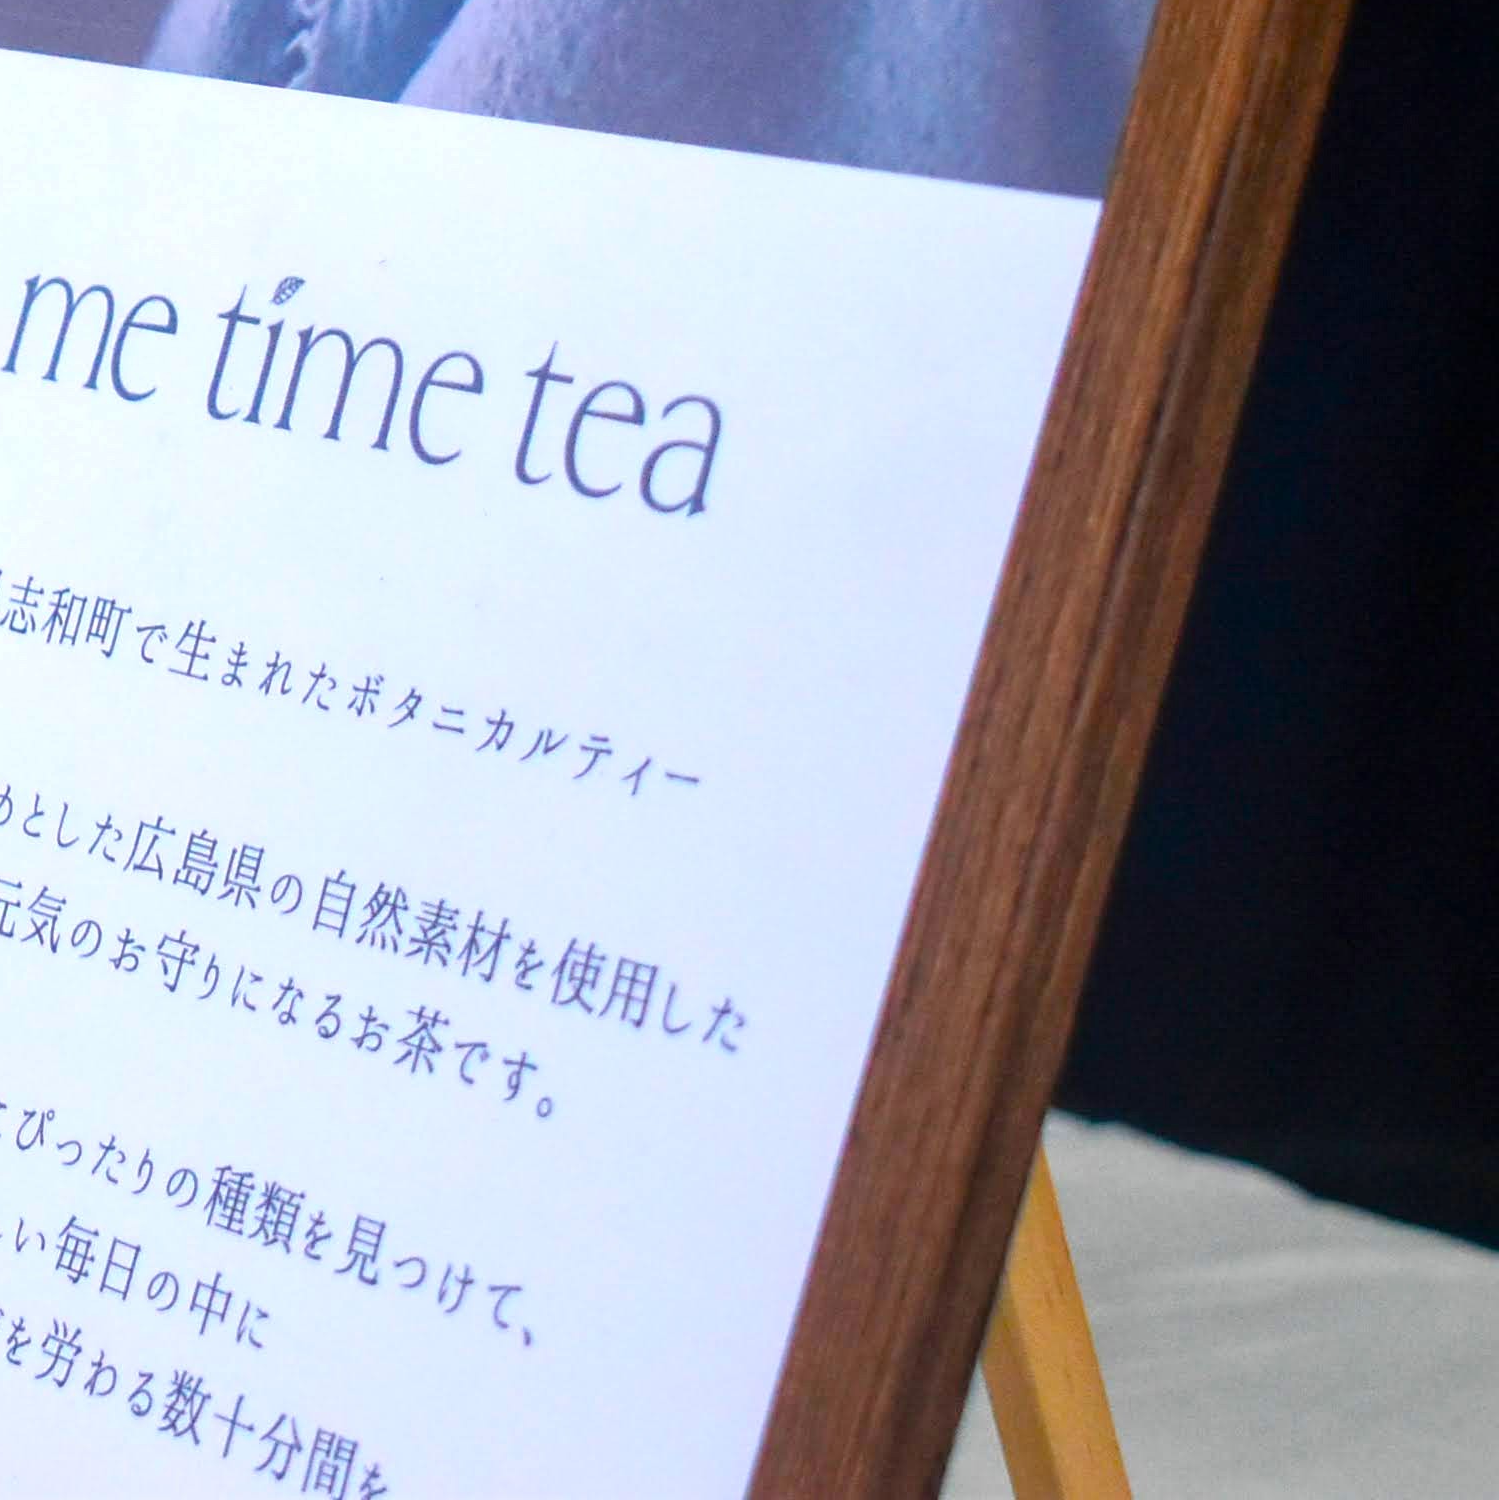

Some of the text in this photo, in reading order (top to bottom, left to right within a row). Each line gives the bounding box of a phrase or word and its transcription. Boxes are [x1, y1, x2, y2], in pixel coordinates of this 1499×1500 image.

[1, 274, 722, 517] me time tea
